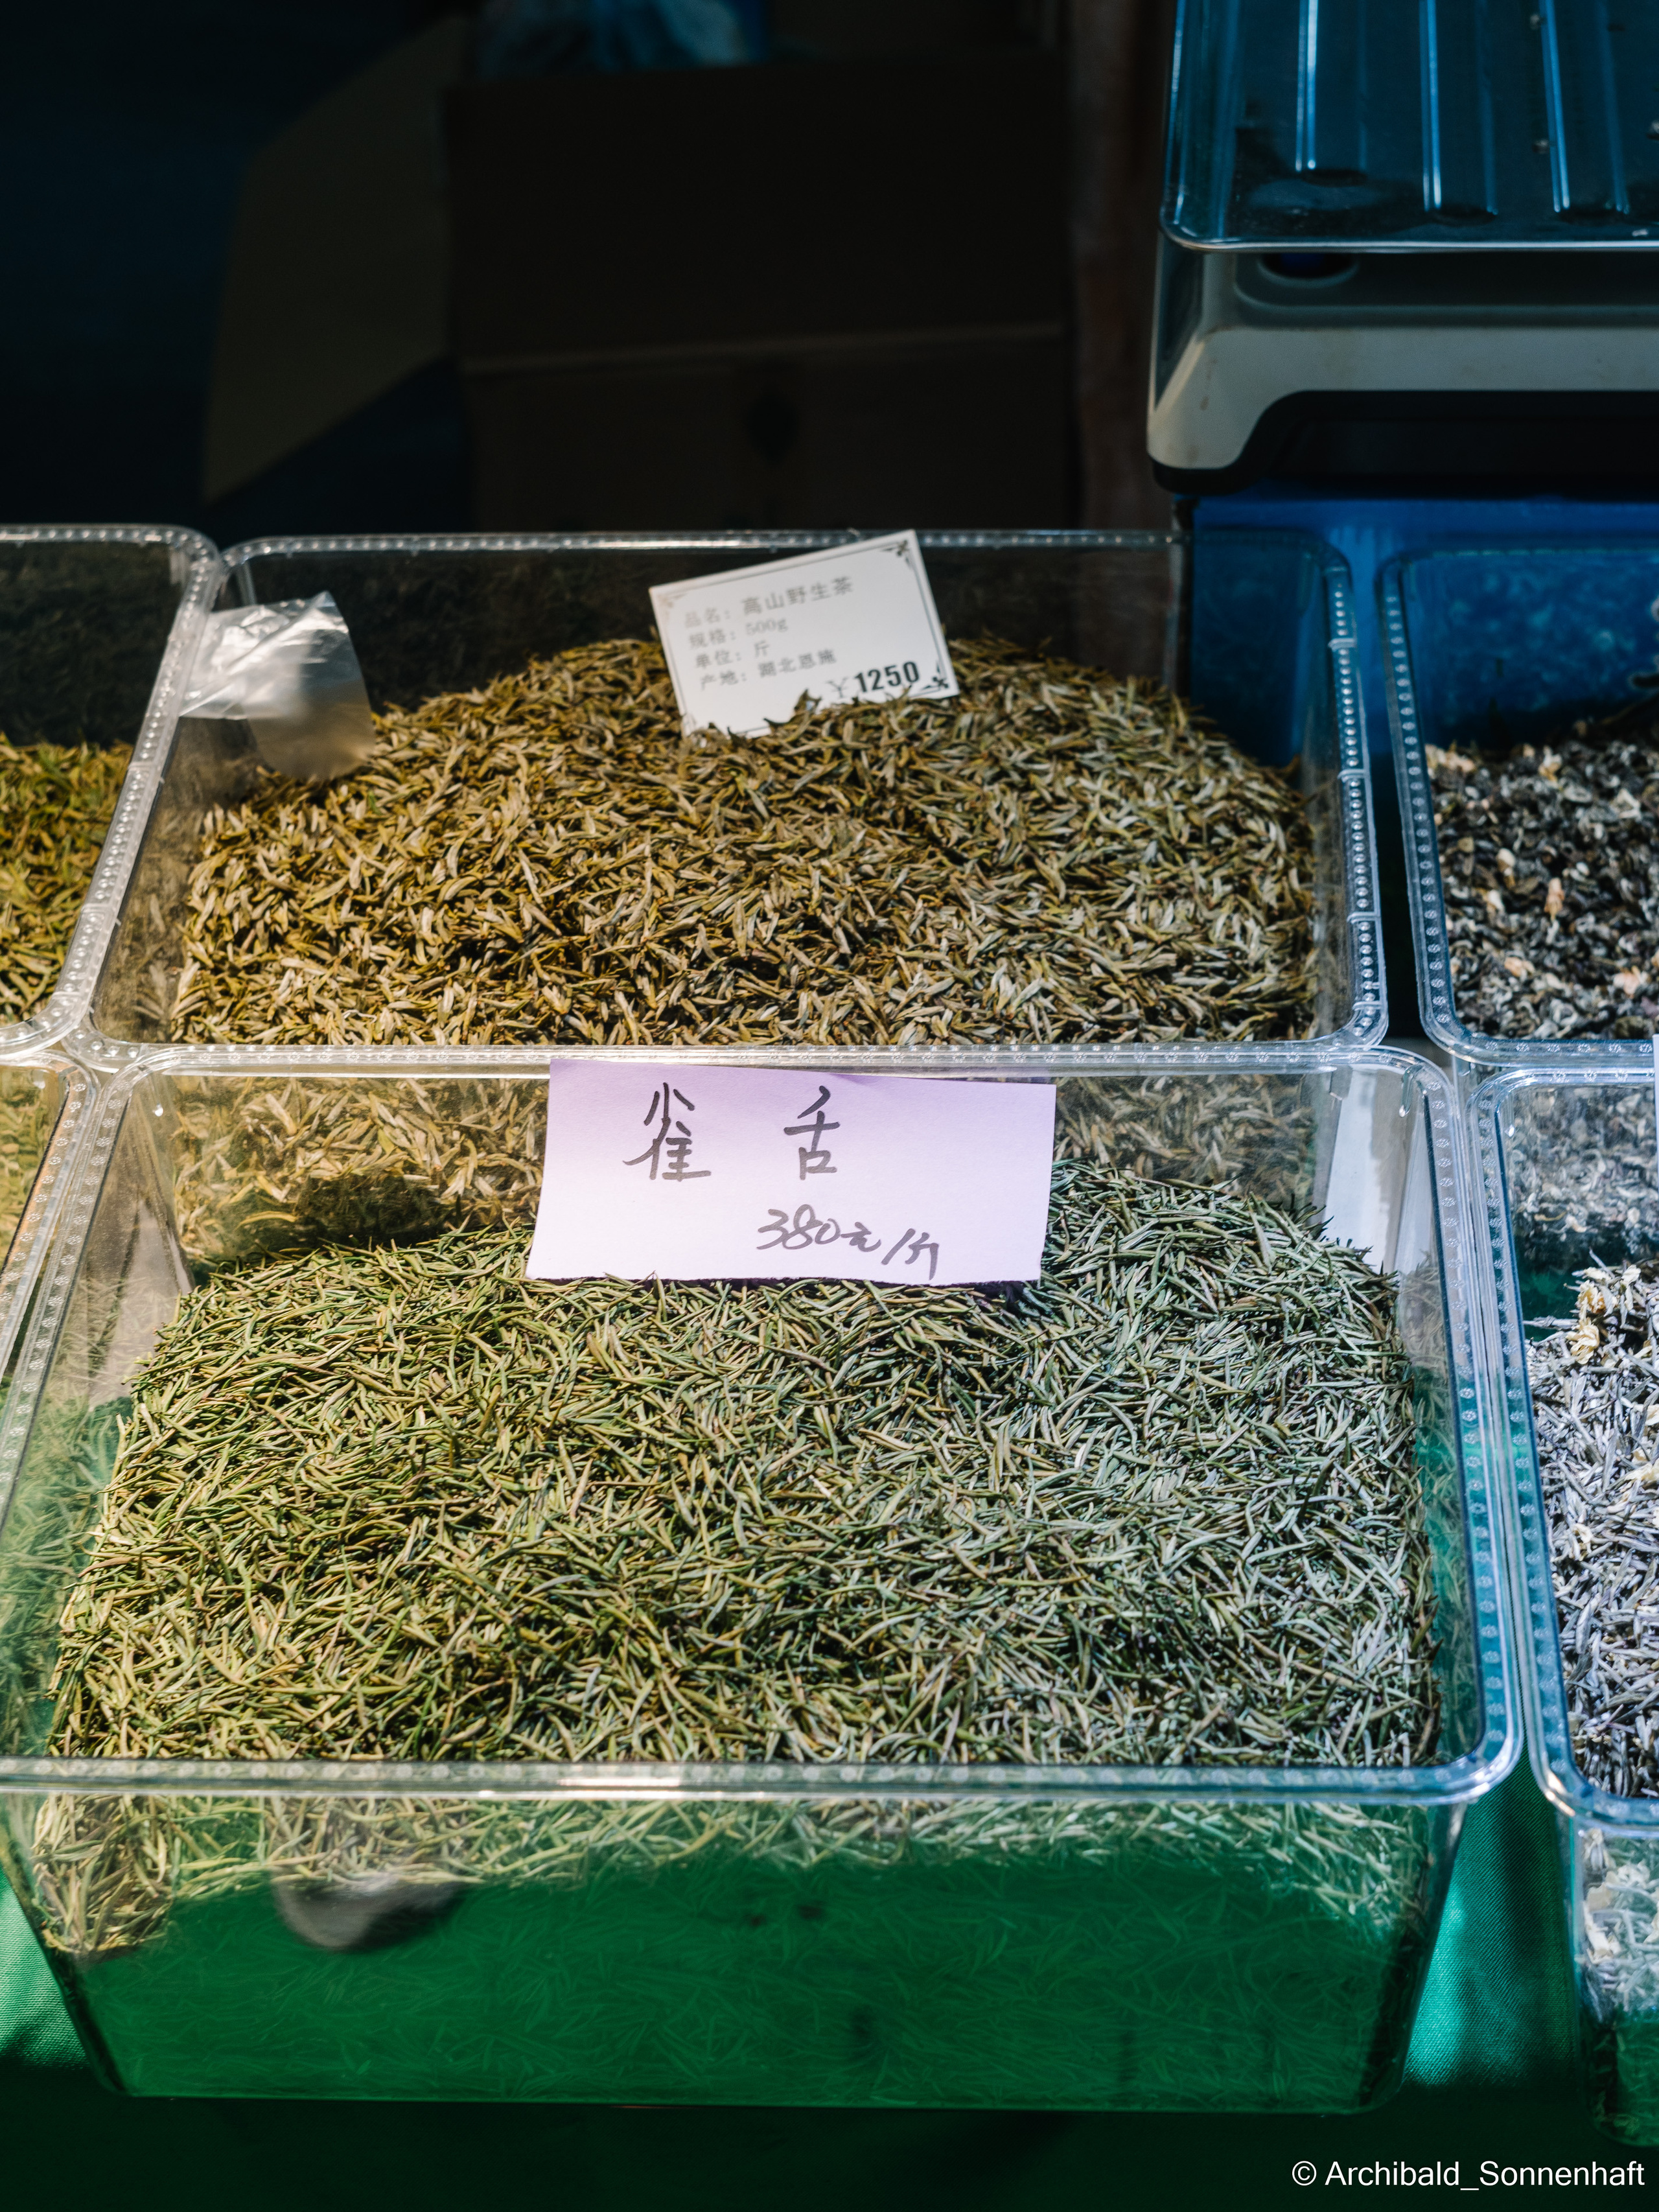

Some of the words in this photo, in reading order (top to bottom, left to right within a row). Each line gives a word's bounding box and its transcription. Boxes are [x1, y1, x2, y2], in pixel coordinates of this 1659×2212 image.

[741, 576, 854, 616] 高山野生茶
[746, 618, 789, 636] 500g
[754, 639, 771, 658] 斤
[758, 648, 837, 678] 湖北恩施
